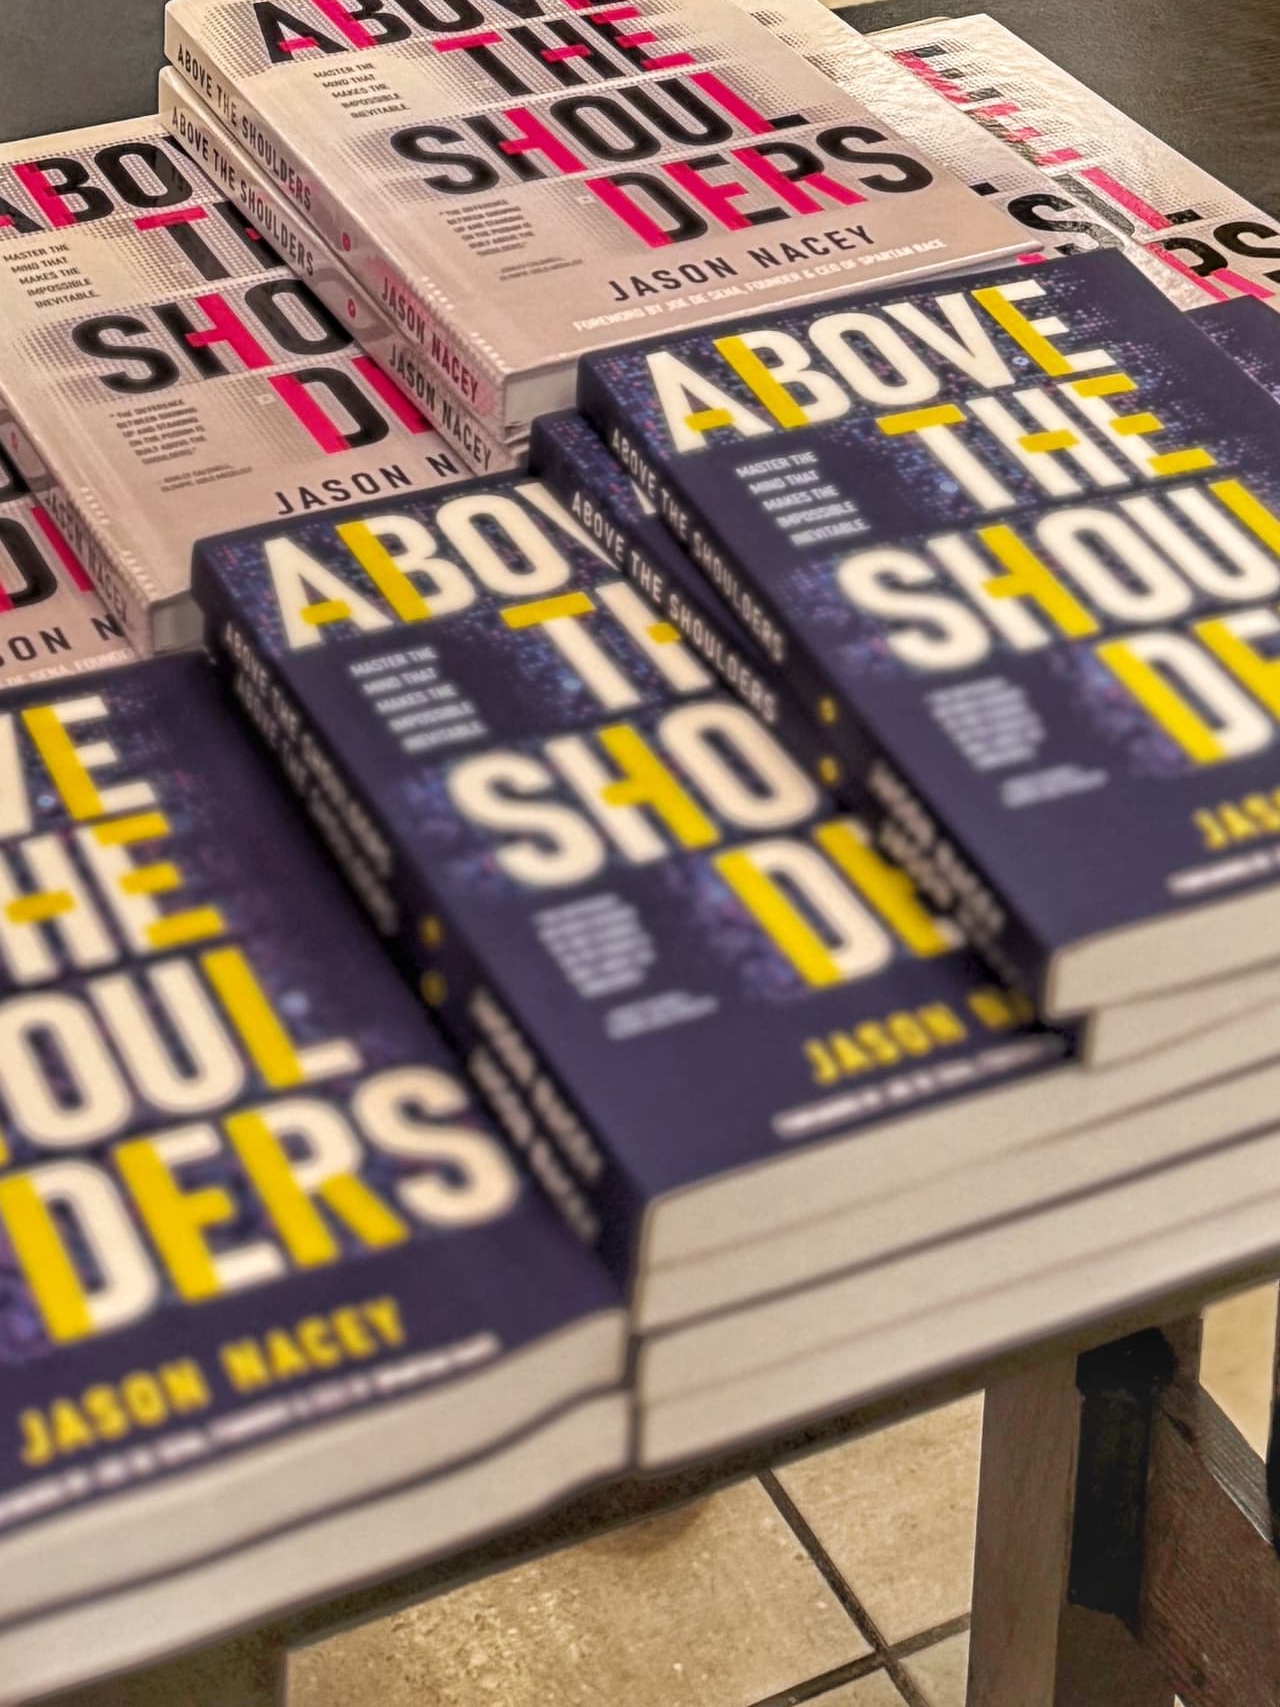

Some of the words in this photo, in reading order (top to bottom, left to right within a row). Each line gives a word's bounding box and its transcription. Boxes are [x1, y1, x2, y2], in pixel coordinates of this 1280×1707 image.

[432, 4, 697, 97] THE
[390, 71, 814, 195] SHOUL
[588, 122, 933, 250] DERS
[608, 257, 737, 301] JASON
[748, 225, 876, 269] NACEY
[644, 278, 1116, 457] ABOVE
[876, 370, 1218, 516] THE
[18, 1356, 210, 1467] JASON
[222, 1296, 408, 1397] NACEY
